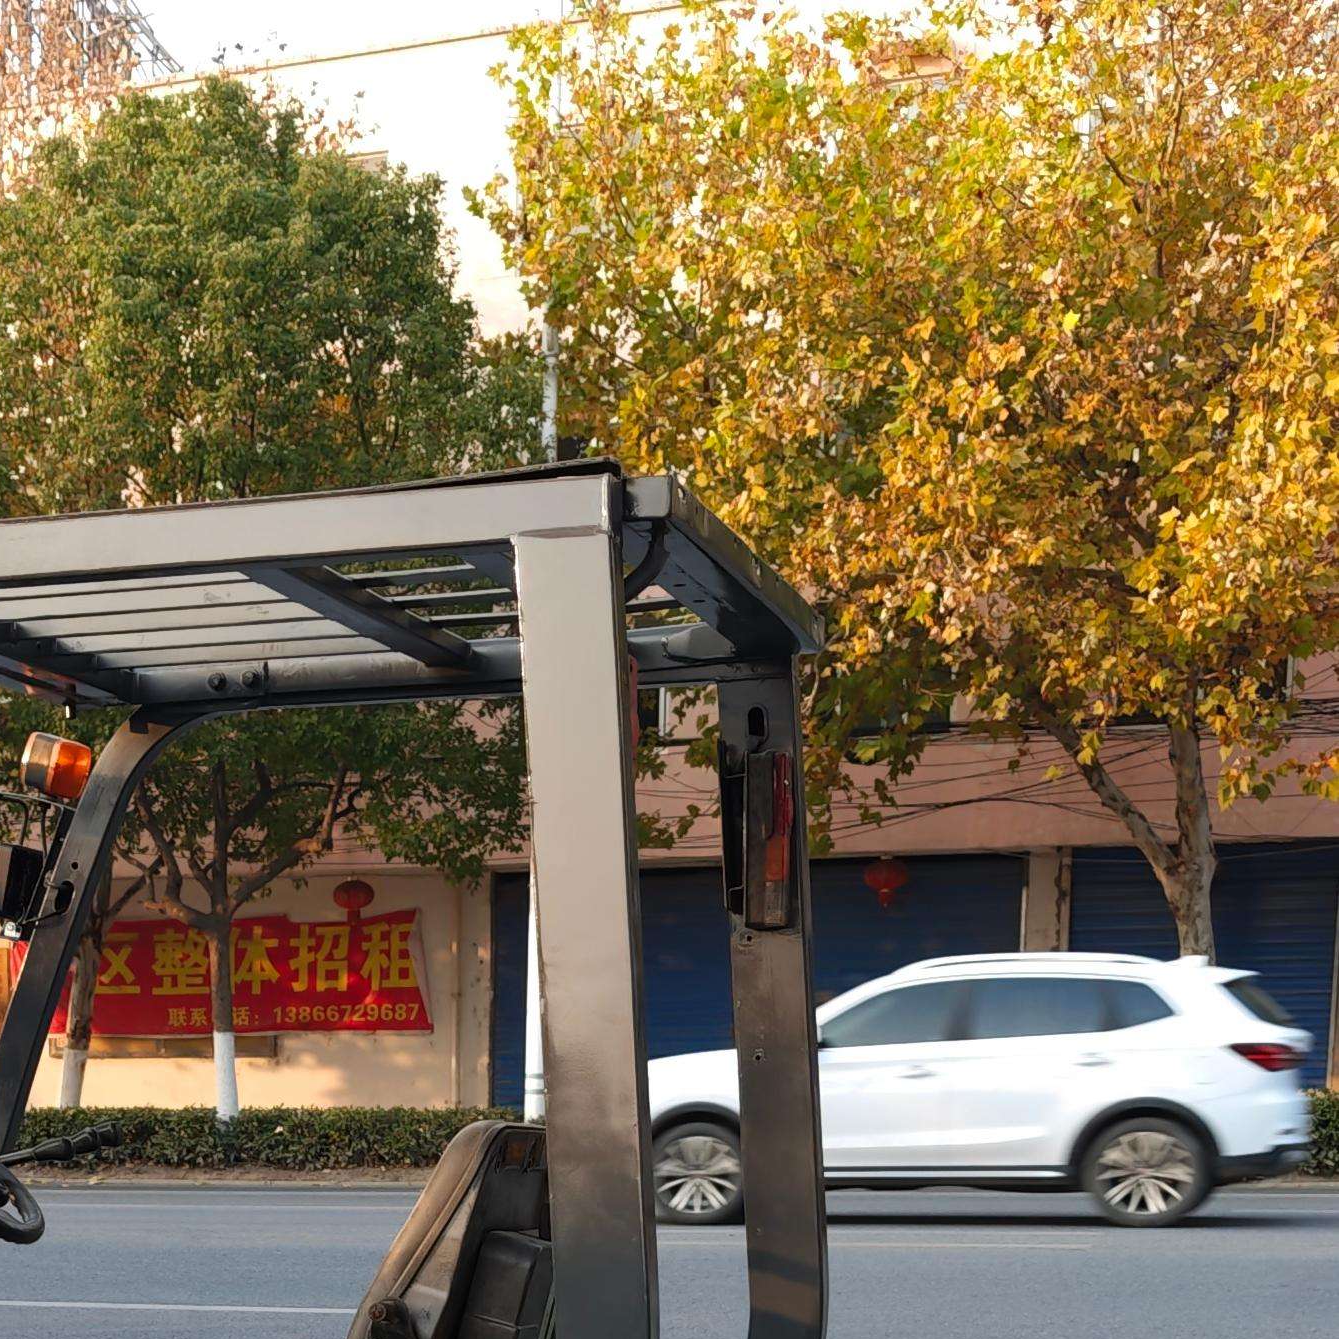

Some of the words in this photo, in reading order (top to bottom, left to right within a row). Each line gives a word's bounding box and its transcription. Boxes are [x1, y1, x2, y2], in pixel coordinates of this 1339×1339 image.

[95, 921, 419, 995] 区整体招租
[168, 1006, 260, 1028] 联系话：
[273, 1003, 419, 1024] 13866729687
